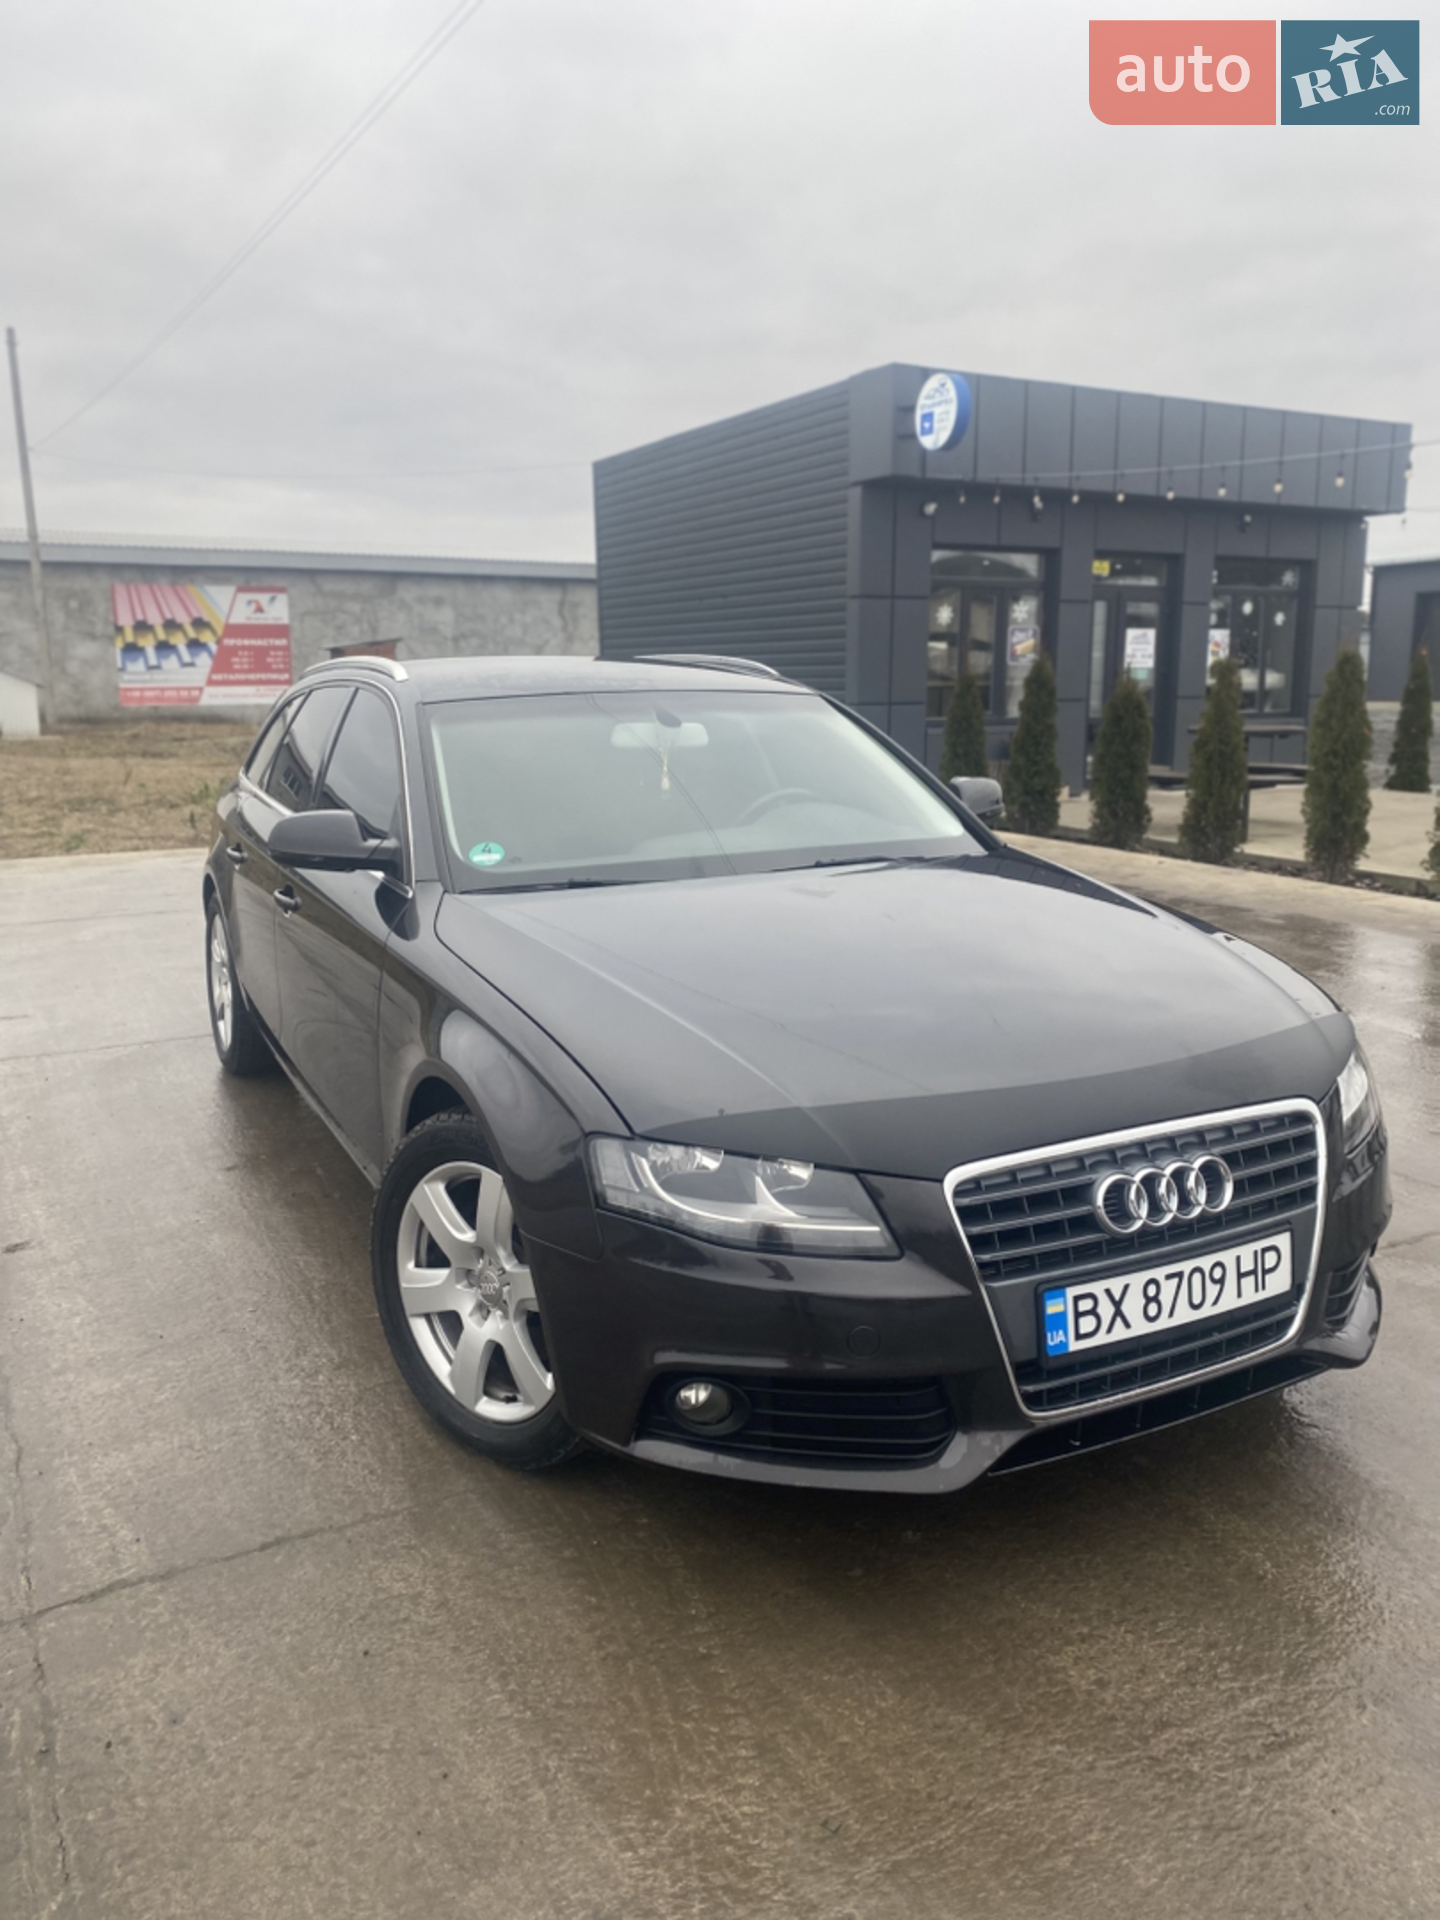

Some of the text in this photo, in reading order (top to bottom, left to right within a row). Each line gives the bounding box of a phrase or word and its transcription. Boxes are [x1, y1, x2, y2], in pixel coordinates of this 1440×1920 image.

[223, 637, 288, 646] ПРОФНАСТИЛ
[1073, 1244, 1282, 1342] BX 8709 HP
[1047, 1329, 1066, 1346] UA
